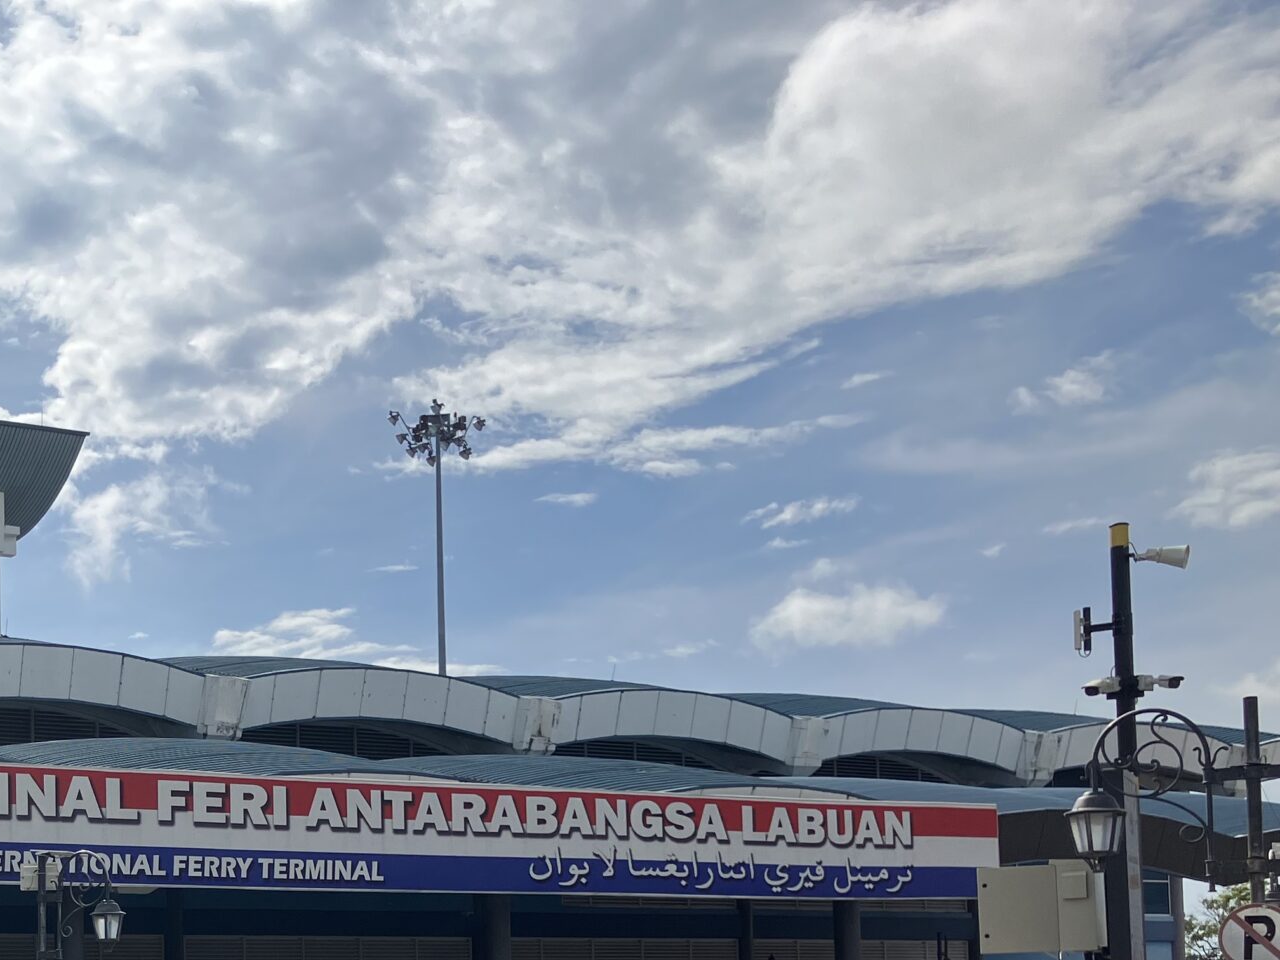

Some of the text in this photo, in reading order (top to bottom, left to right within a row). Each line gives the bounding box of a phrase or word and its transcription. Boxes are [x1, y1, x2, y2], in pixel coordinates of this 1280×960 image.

[156, 778, 289, 829] FERI
[306, 786, 730, 843] ANTARABANGSA
[740, 805, 914, 848] LABUAN
[172, 854, 255, 880] FERRY
[257, 857, 385, 882] TERMINAL
[1244, 915, 1276, 960] P
